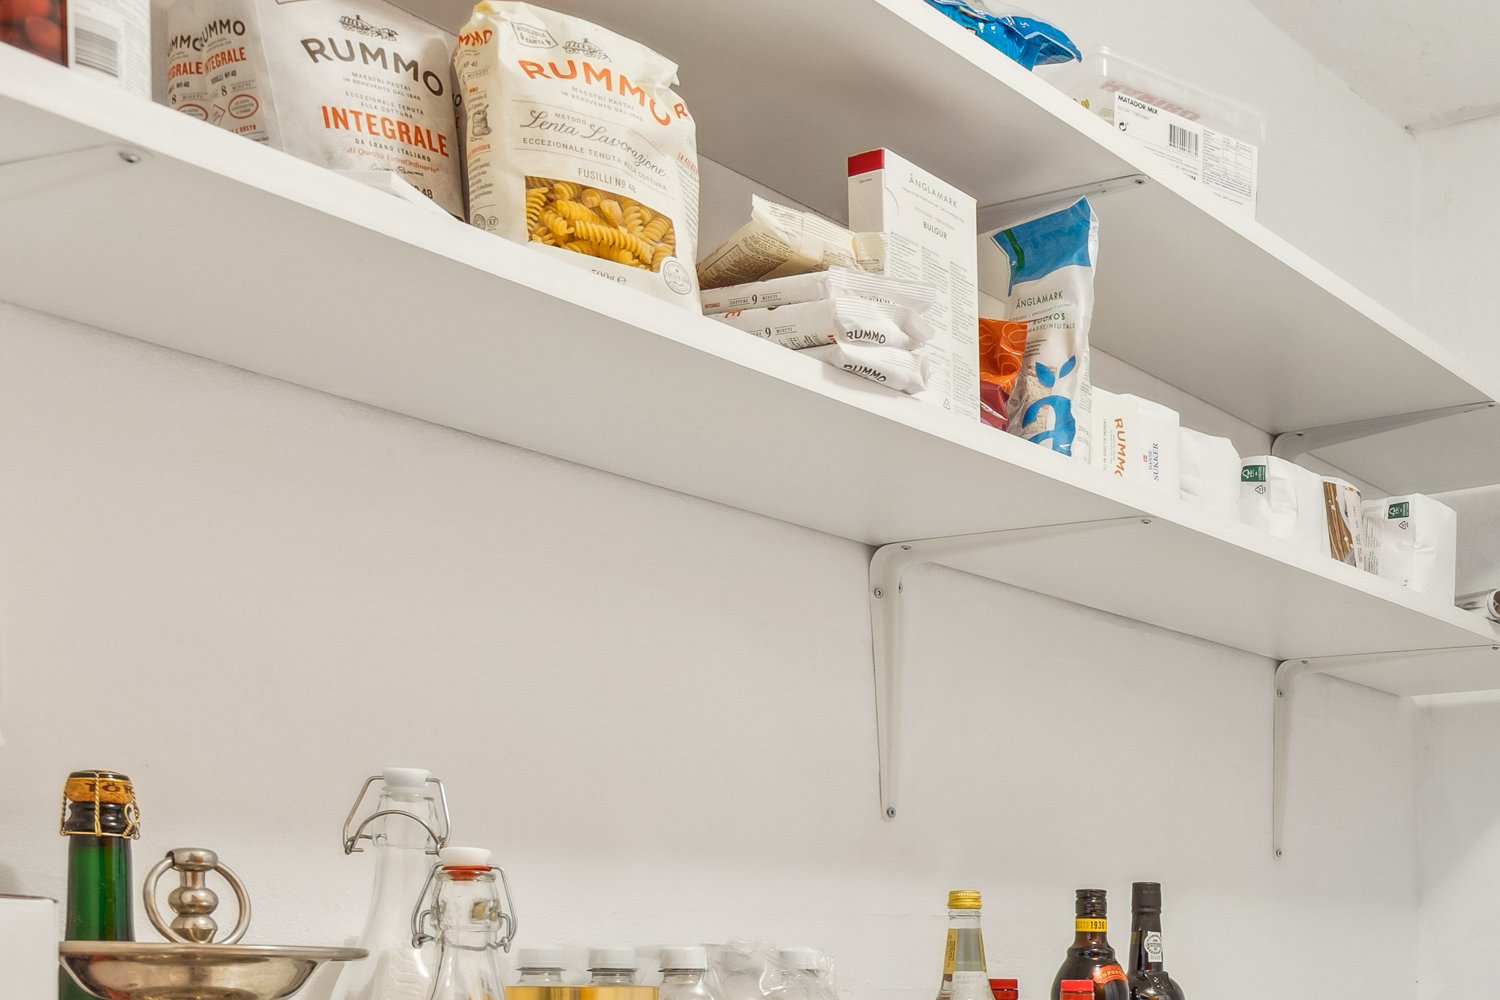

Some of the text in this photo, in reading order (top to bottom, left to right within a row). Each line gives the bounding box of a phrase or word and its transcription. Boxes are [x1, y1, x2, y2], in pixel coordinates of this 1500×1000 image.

[300, 37, 444, 97] RUMMO
[519, 59, 671, 126] RUMMO
[398, 103, 424, 115] TENUTA
[1118, 95, 1147, 110] MATADOR
[1147, 106, 1159, 116] MIX
[554, 112, 587, 125] METODO
[320, 105, 449, 158] INTEGRALE
[520, 109, 579, 136] Lenta
[580, 123, 667, 177] Lavorazione
[523, 137, 585, 153] ECCEZIONALE
[588, 148, 622, 163] TENUTA
[397, 148, 432, 162] ITALIANO
[577, 167, 612, 185] FUSILLI
[923, 221, 947, 239] BULGUR
[751, 295, 758, 305] 9
[764, 327, 772, 337] 9
[846, 329, 887, 344] RUMMO
